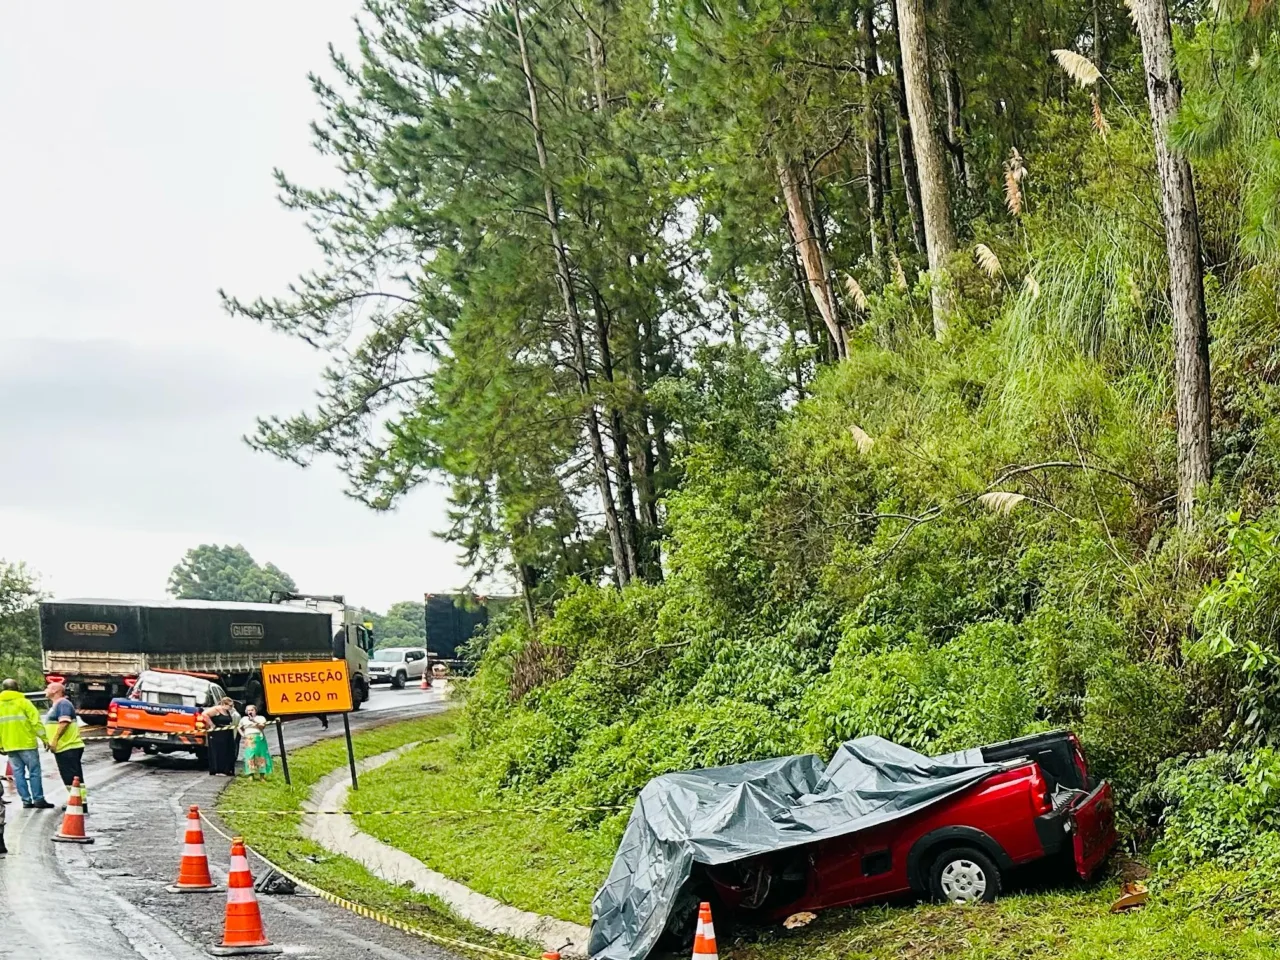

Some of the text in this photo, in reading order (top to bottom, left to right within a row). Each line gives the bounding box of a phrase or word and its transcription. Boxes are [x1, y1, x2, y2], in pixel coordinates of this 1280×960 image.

[69, 623, 113, 631] GUERRA
[268, 669, 343, 684] INTERSEÇÃO
[281, 691, 338, 703] A 200 m
